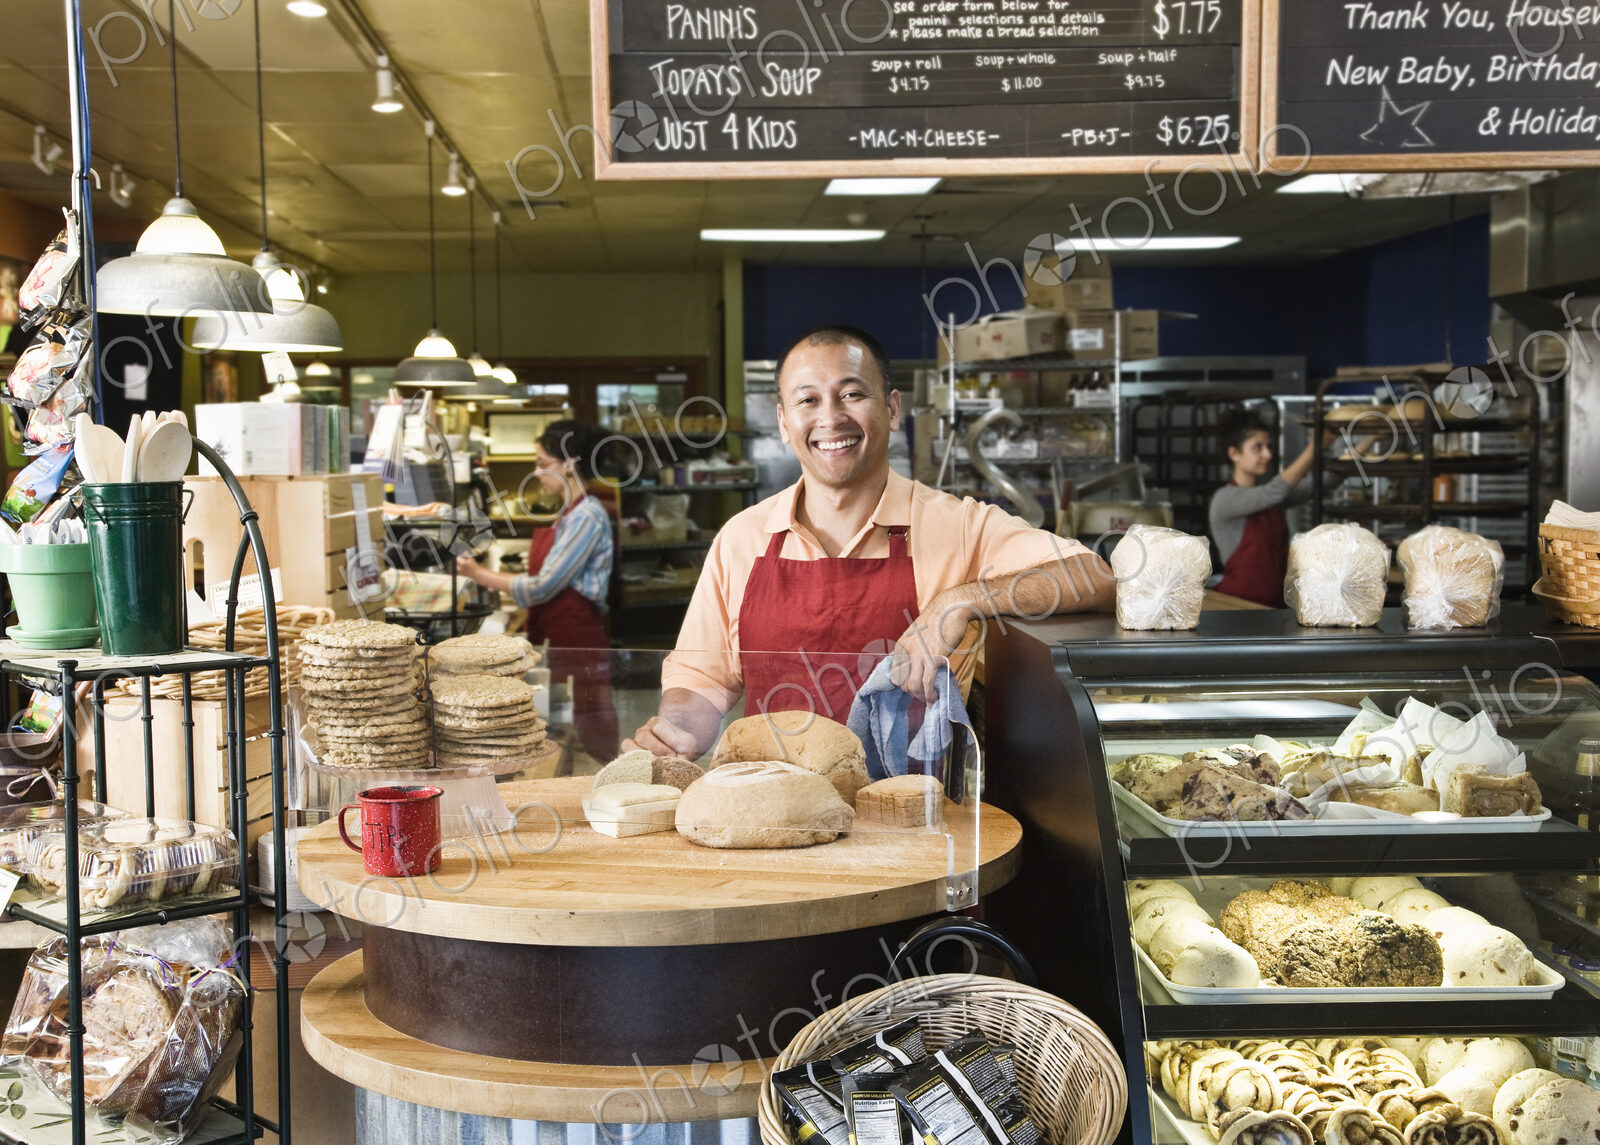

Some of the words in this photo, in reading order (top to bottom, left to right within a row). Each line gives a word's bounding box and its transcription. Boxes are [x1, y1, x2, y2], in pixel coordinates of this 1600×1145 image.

[893, 1, 915, 14] see
[922, 0, 959, 13] order
[962, 0, 995, 12] form
[1002, 0, 1039, 11] below
[908, 14, 947, 29] panini
[958, 13, 1024, 25] selections
[1029, 13, 1055, 25] and
[1061, 11, 1105, 24] details
[1153, 0, 1222, 40] $7.75
[1344, 1, 1429, 30] Thank
[1442, 2, 1495, 32] You,
[902, 27, 942, 41] please
[947, 27, 983, 38] make
[986, 29, 994, 37] a
[997, 26, 1035, 38] bread
[1038, 25, 1099, 37] selection
[915, 55, 942, 69] roll
[1018, 52, 1056, 65] whole
[1148, 49, 1178, 62] half
[761, 62, 821, 97] SOUP
[1326, 55, 1389, 86] New
[1397, 56, 1476, 91] Baby,
[888, 76, 930, 93] $4.75
[1124, 74, 1165, 90] $9.75
[1478, 106, 1502, 136] &
[655, 117, 708, 151] JUST
[722, 113, 739, 150] 4
[748, 116, 797, 150] KIDS
[933, 1083, 946, 1093] Facts
